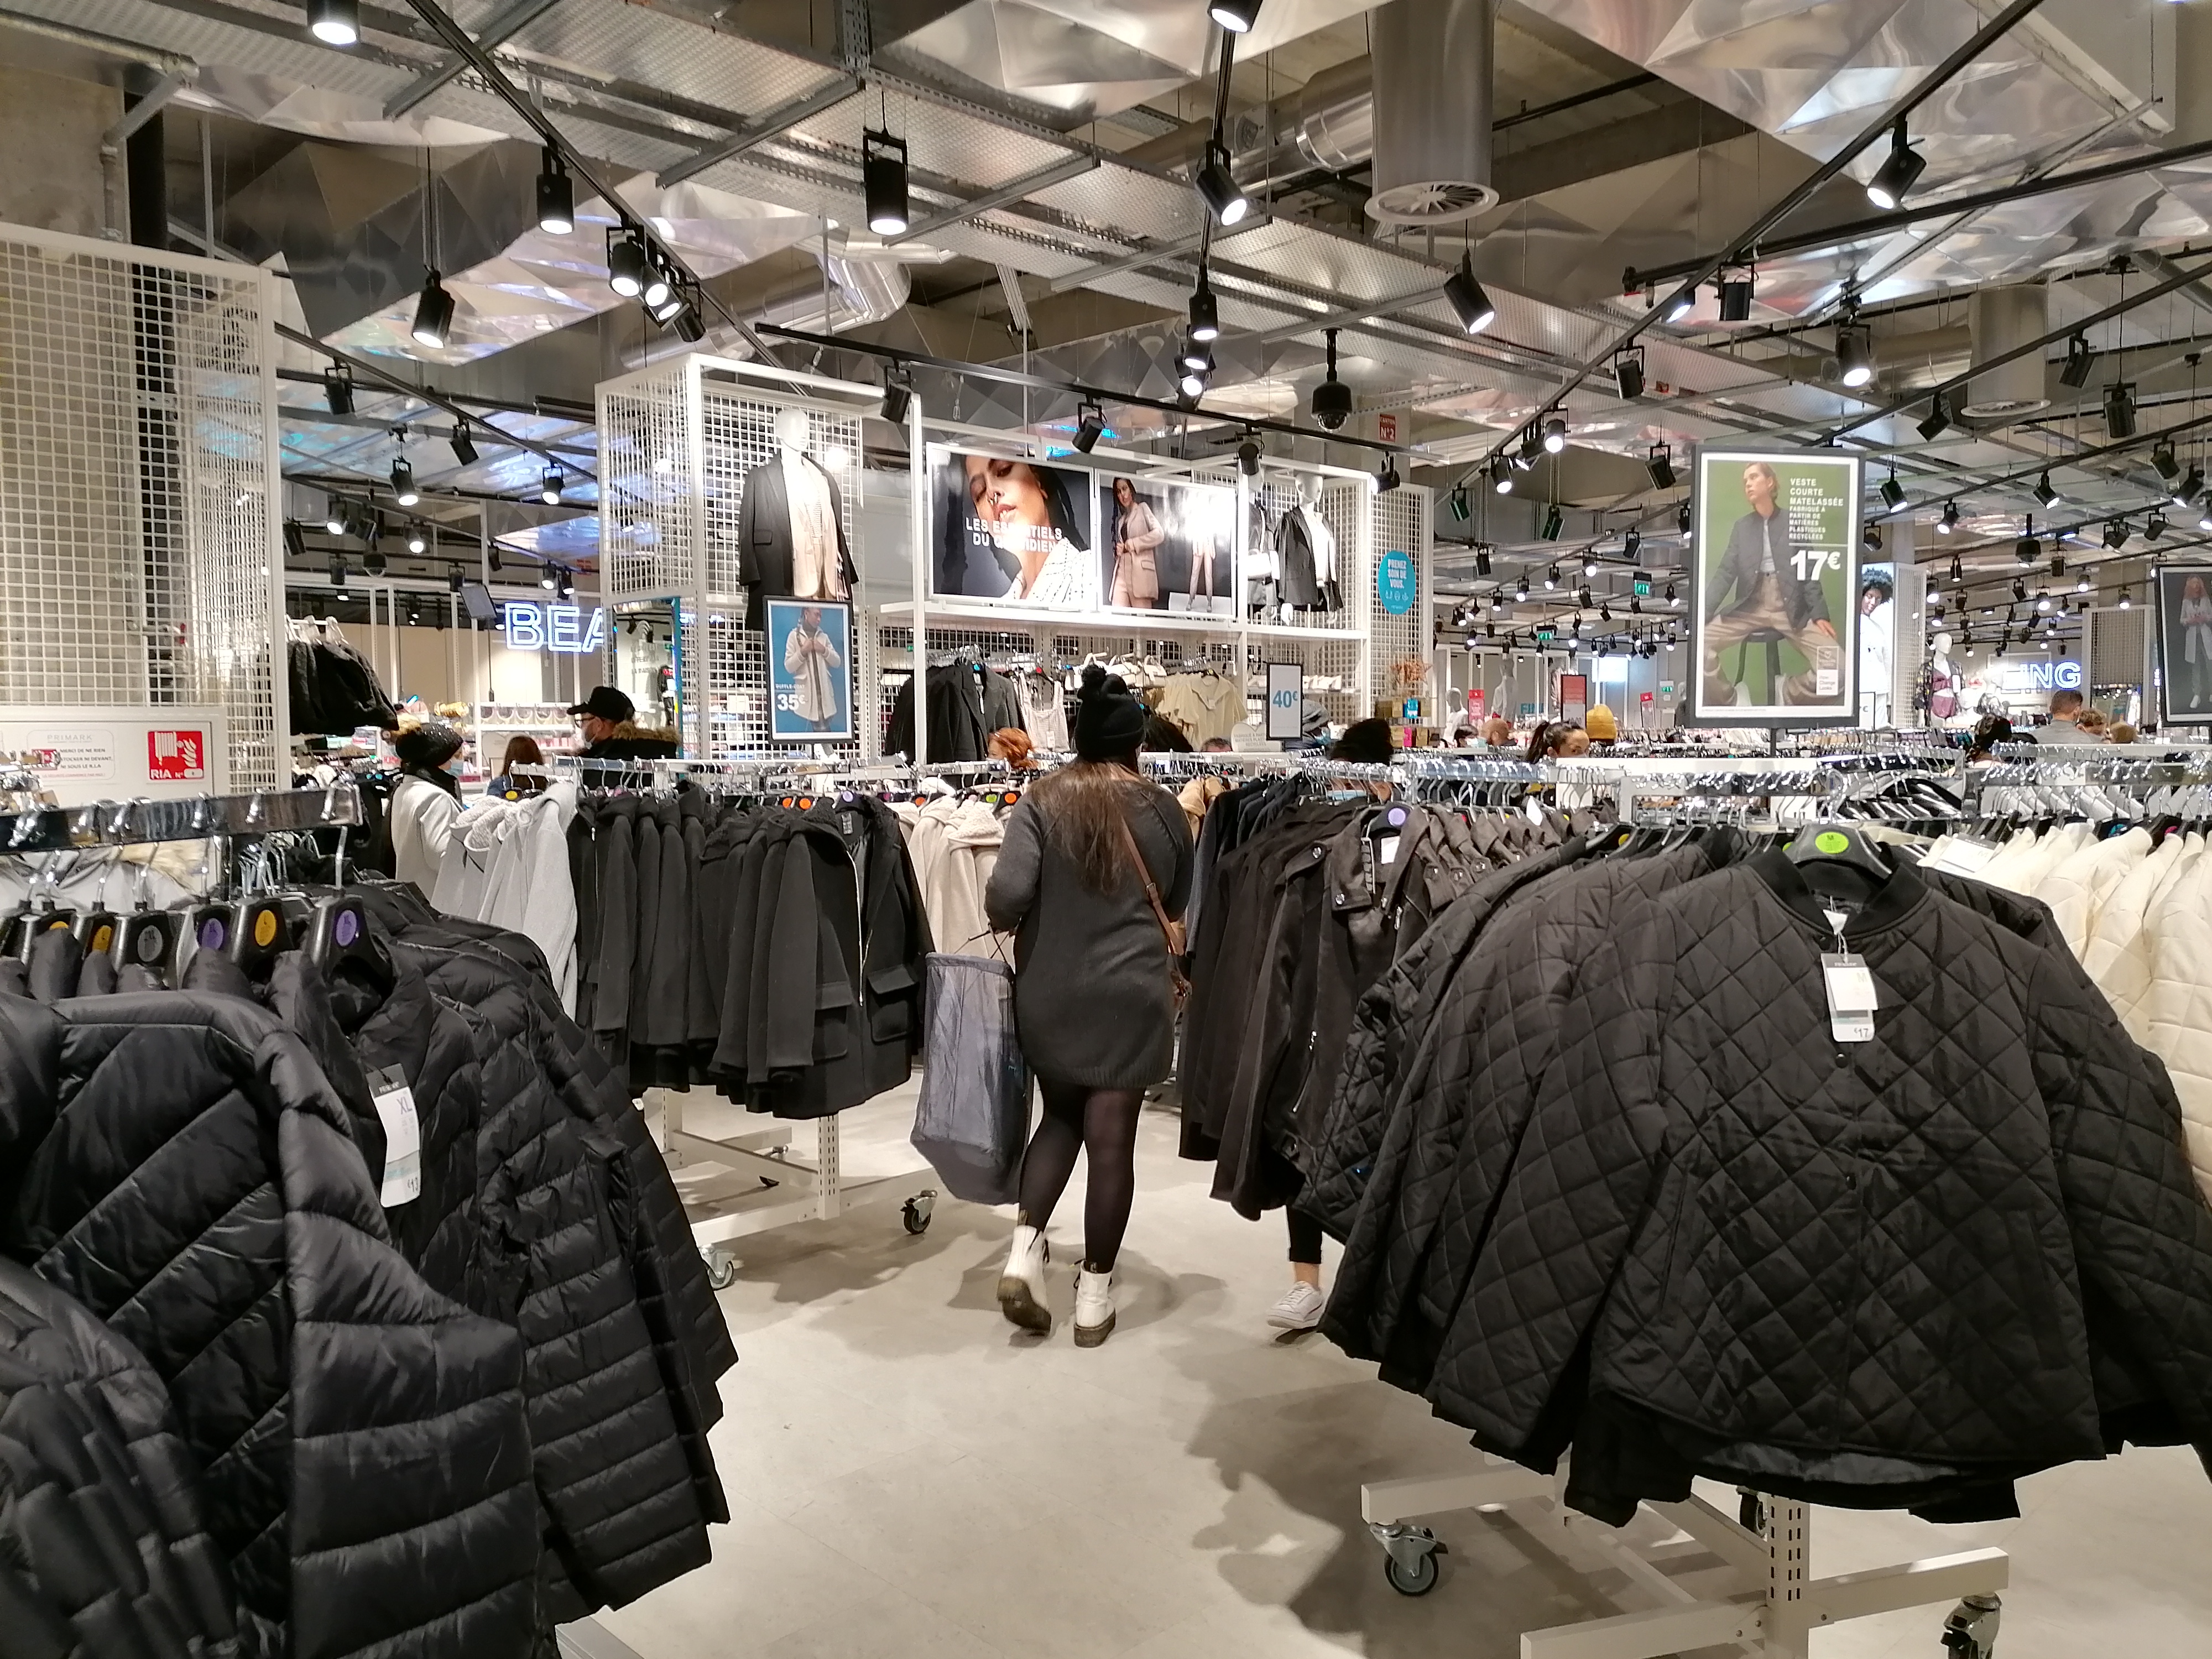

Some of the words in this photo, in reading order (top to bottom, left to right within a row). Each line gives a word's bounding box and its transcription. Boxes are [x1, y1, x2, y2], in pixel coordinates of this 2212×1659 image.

[1790, 478, 1817, 486] VESTE
[1790, 488, 1824, 496] COURTE
[1790, 497, 1844, 506] MATELASSÉE
[966, 517, 989, 532] LES
[973, 532, 990, 546] DU
[1790, 549, 1841, 581] 17€
[1272, 690, 1298, 708] 40€
[150, 769, 172, 779] RIA
[1856, 972, 1868, 983] M
[396, 1096, 413, 1115] XL
